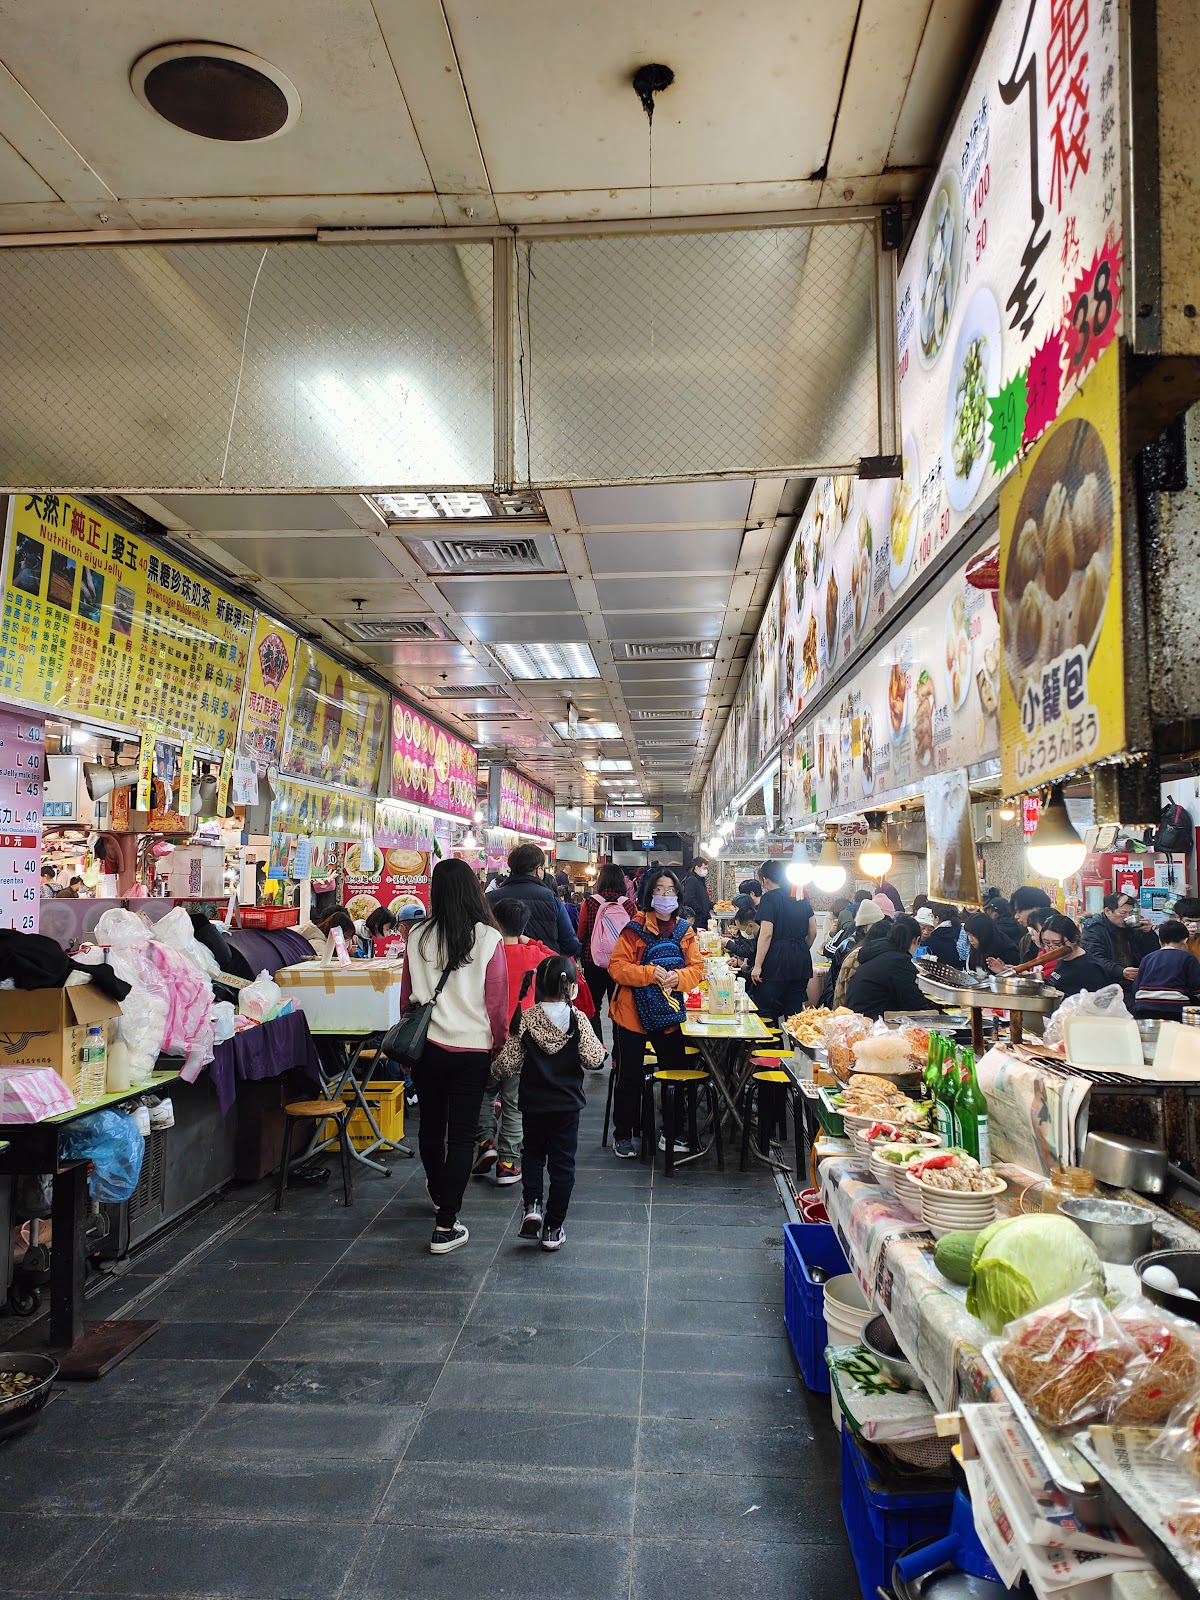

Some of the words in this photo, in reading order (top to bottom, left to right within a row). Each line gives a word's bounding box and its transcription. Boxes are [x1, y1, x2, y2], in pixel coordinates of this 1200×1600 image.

[972, 163, 990, 219] 100
[975, 218, 988, 262] 50
[919, 532, 931, 566] 100
[940, 508, 950, 541] 50
[40, 524, 82, 558] Nutrition
[85, 552, 103, 570] aiyu
[104, 560, 122, 583] Jelly
[147, 555, 212, 612] 黑糖珍珠奶茶
[108, 632, 116, 647] 真
[223, 627, 239, 643] Juice
[1022, 654, 1085, 733] 小籠包
[17, 725, 23, 739] L
[28, 727, 40, 741] 40
[1017, 713, 1097, 778] しょうろんぽう
[16, 753, 22, 767] L
[27, 755, 39, 768] 40
[4, 769, 18, 779] Jelly
[16, 782, 21, 794] L
[27, 783, 39, 796] 45
[15, 810, 21, 823] L
[26, 811, 37, 824] 40
[13, 860, 19, 873] L
[24, 860, 36, 873] 40
[14, 877, 24, 885] tea
[12, 889, 18, 902] L
[23, 888, 35, 901] 45
[11, 918, 17, 931] L
[22, 916, 34, 929] 25
